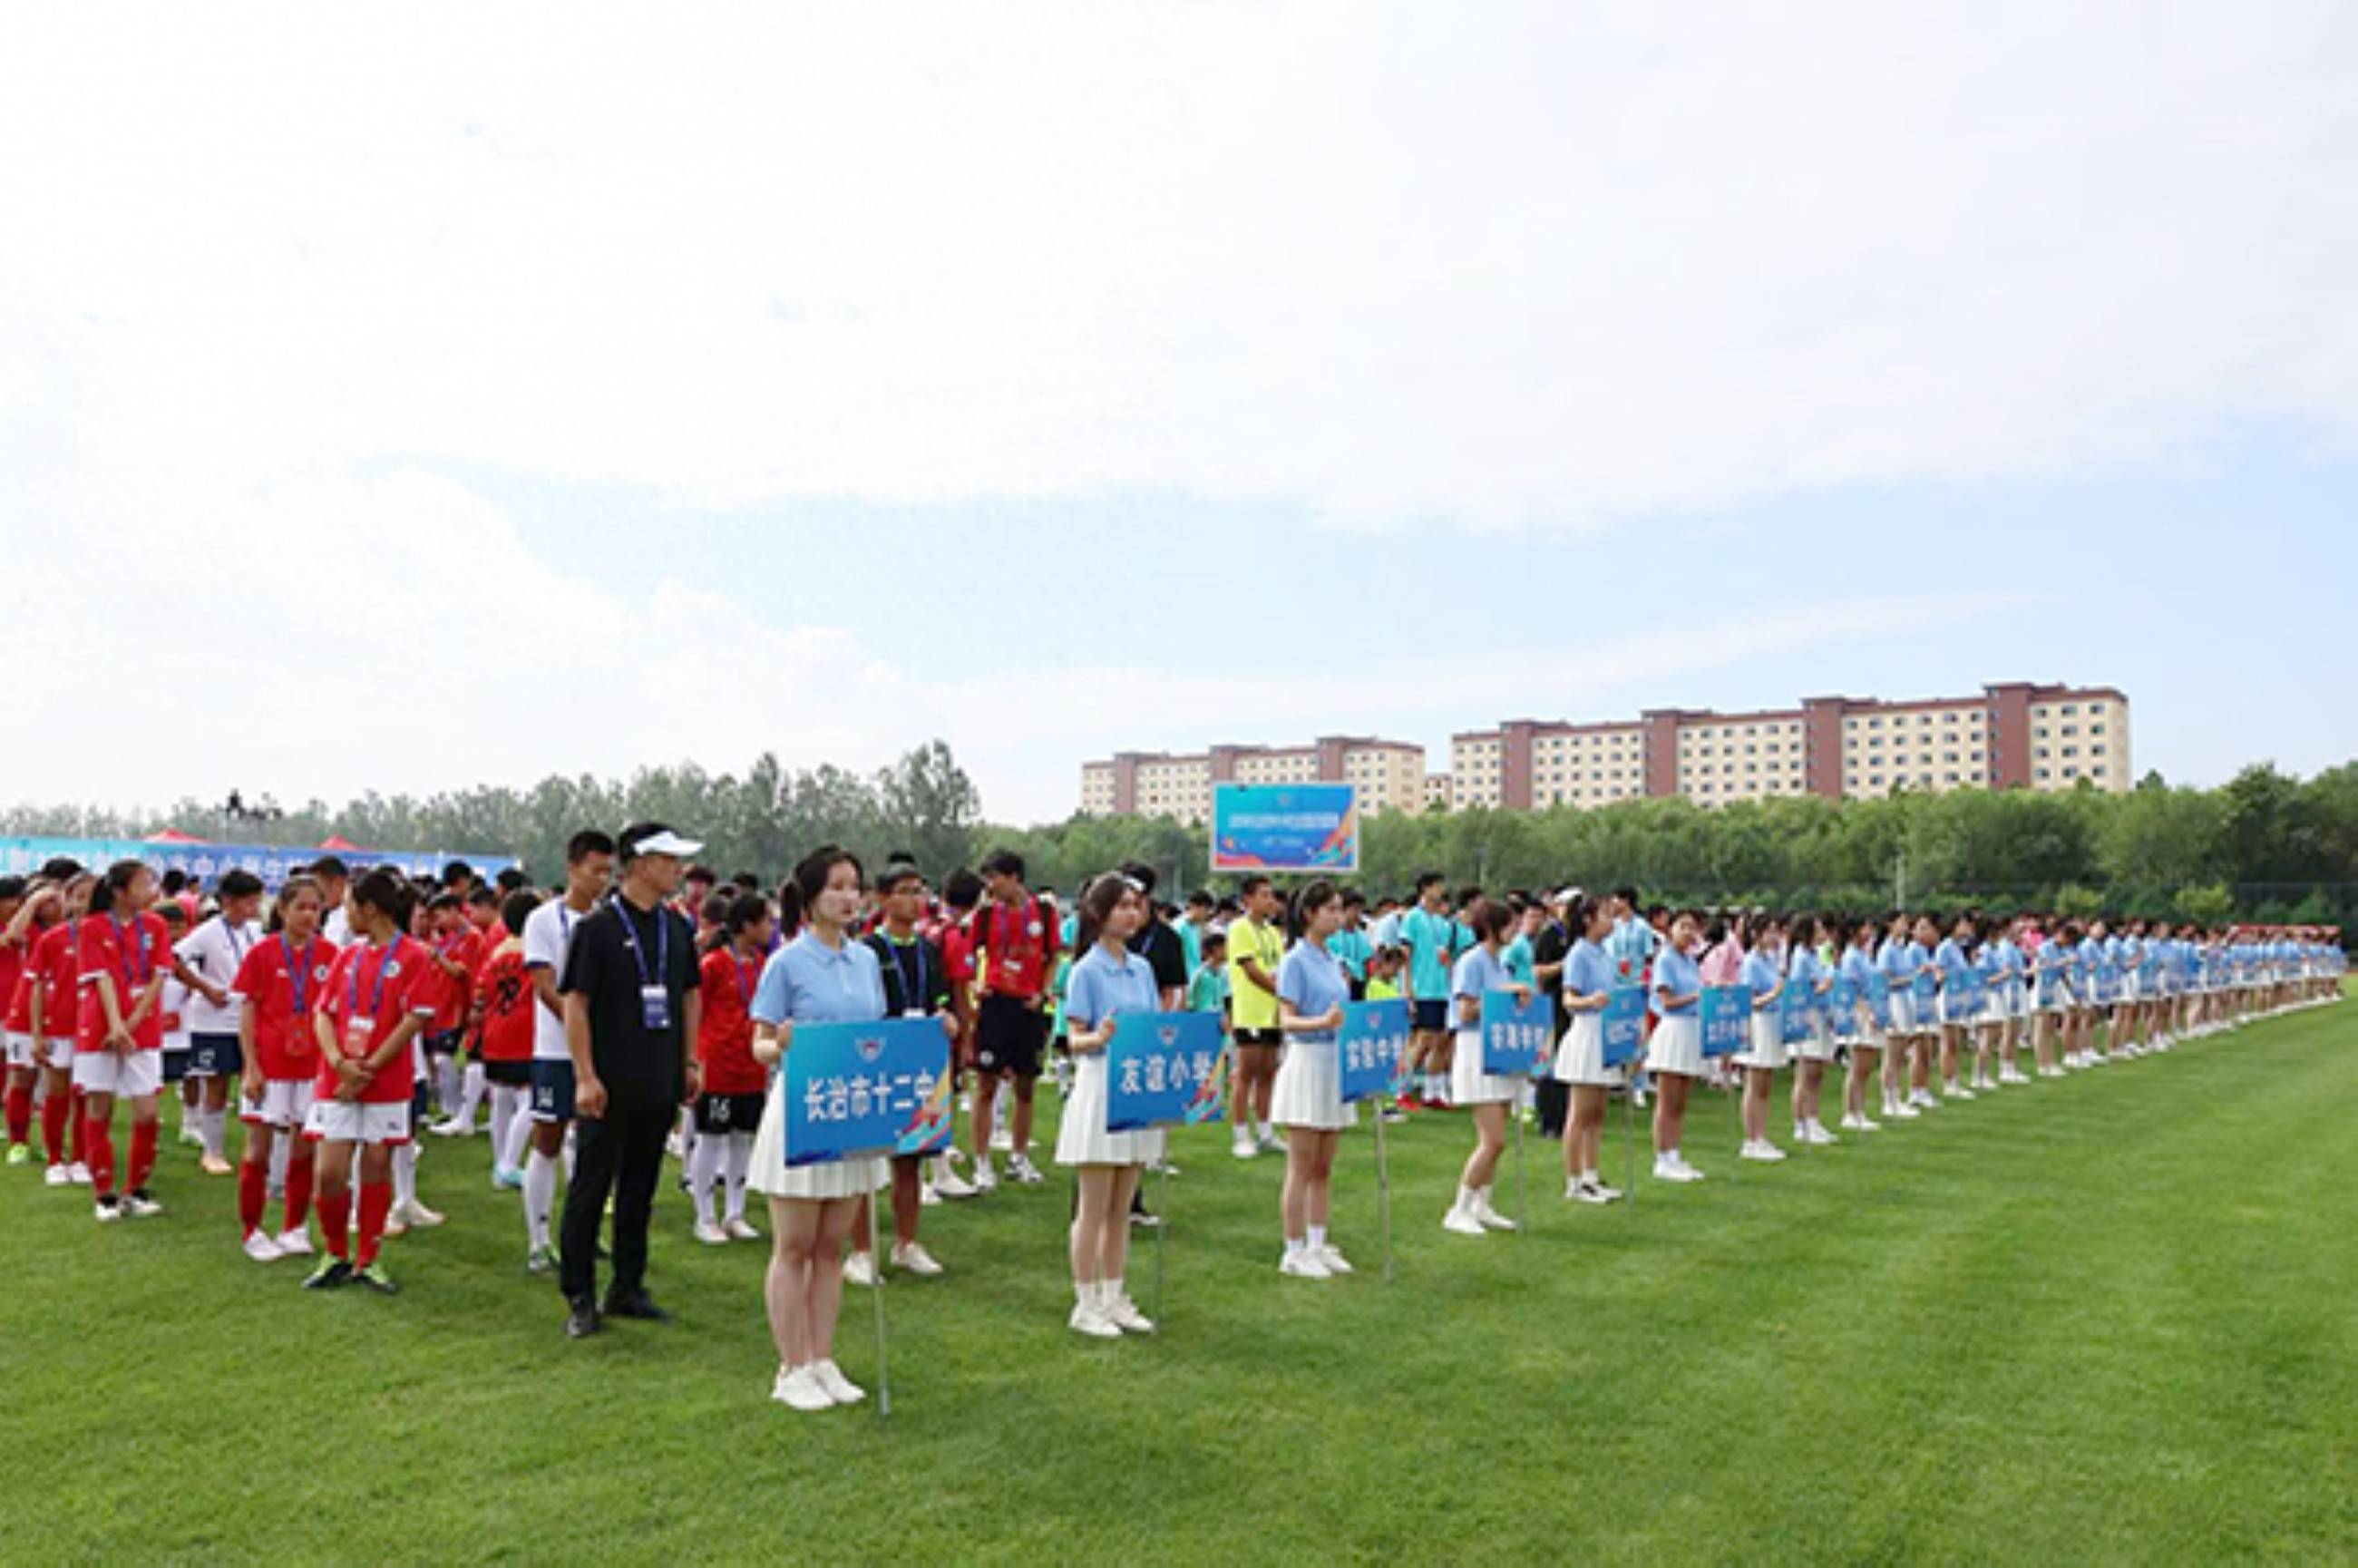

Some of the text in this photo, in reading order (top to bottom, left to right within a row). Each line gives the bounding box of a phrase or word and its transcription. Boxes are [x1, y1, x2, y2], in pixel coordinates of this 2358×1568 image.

[804, 1066, 935, 1123] 长治市十二中
